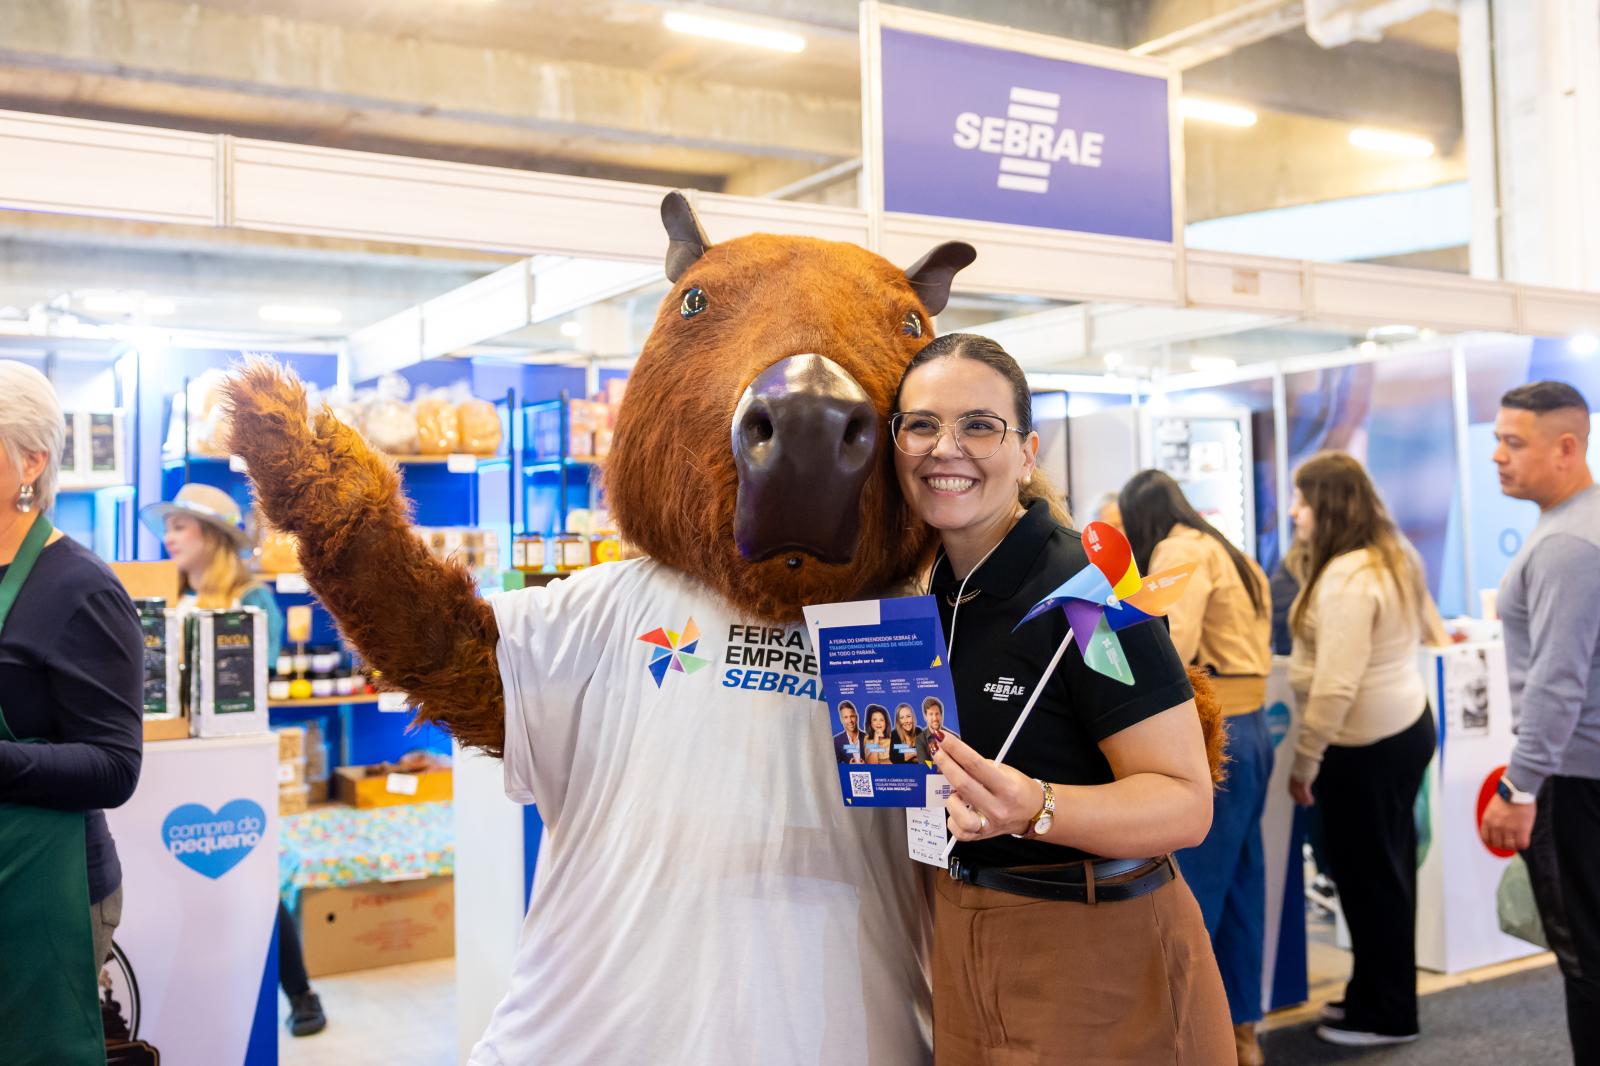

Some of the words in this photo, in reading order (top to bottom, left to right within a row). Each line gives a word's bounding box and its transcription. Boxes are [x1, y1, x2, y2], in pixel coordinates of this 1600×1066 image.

[953, 112, 1104, 168] SEBRAE
[728, 624, 804, 650] FEIRA
[725, 645, 818, 676] EMPRE
[722, 668, 827, 701] SEBRA
[984, 683, 1026, 695] SEBRAE
[169, 820, 234, 839] compre
[237, 816, 260, 832] do
[170, 831, 261, 856] pequeno
